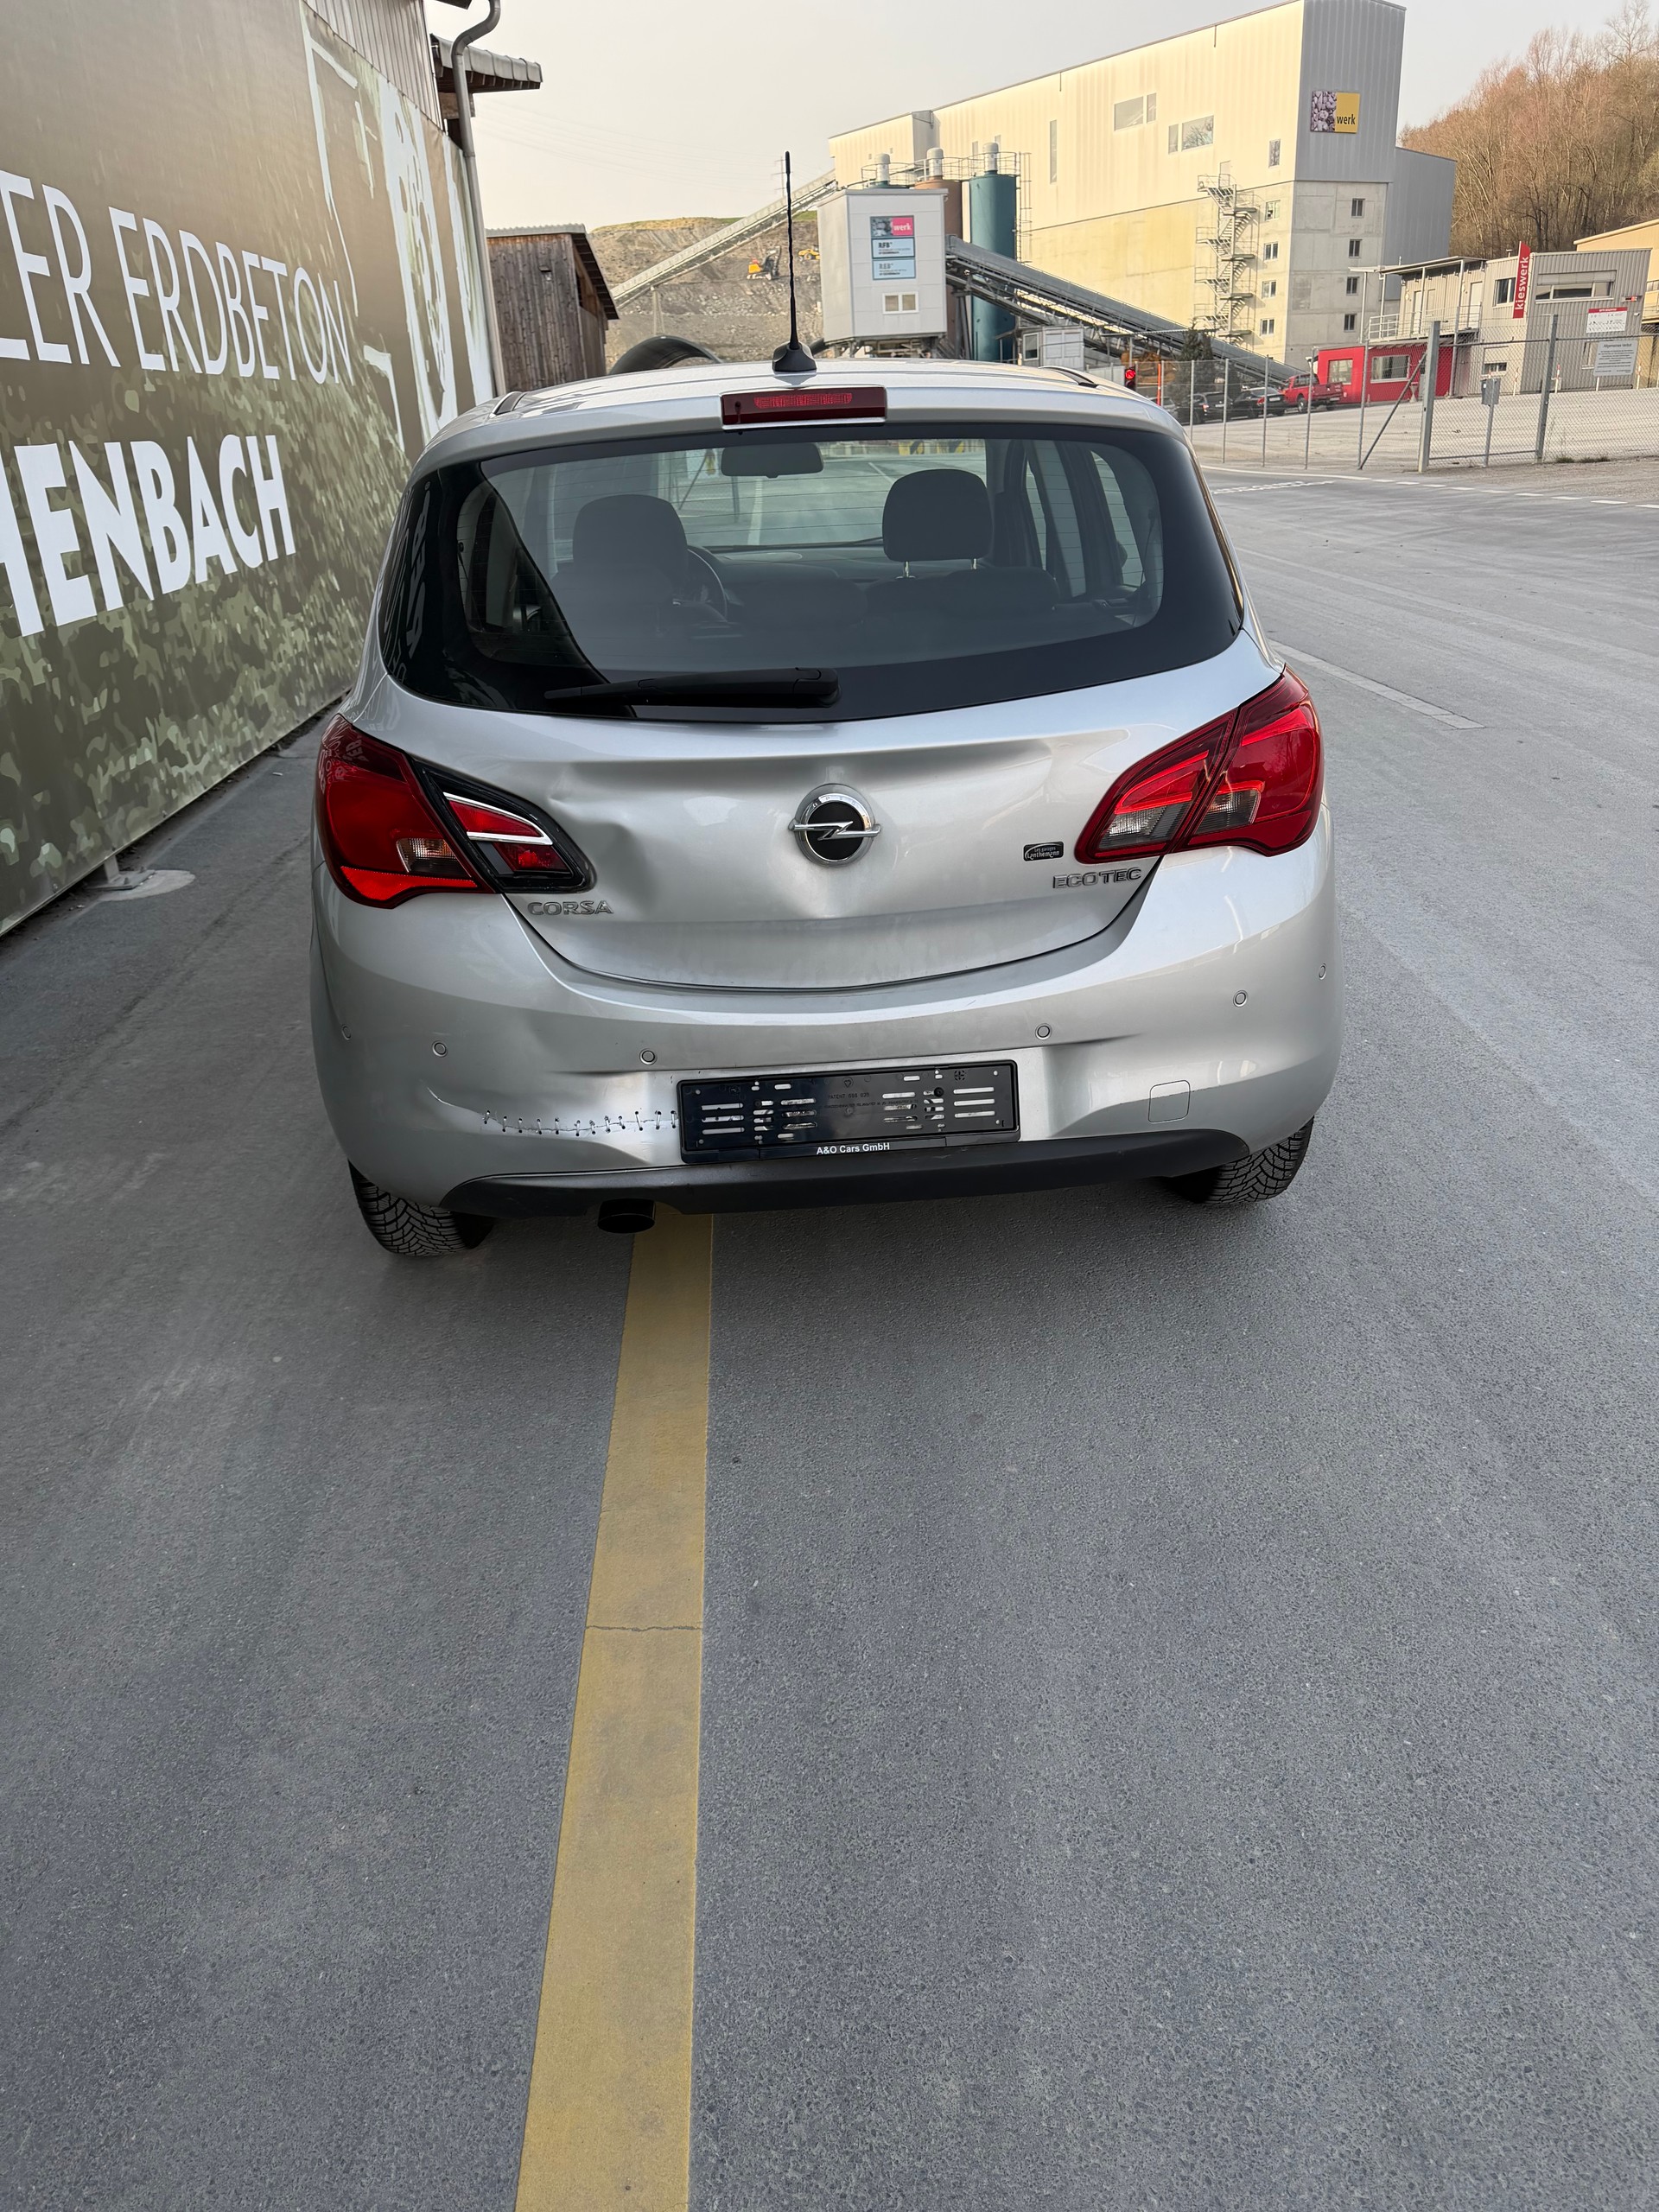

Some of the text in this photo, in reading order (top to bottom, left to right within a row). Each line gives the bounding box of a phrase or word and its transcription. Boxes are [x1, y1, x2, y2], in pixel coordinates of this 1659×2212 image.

[1337, 113, 1356, 125] werk
[893, 222, 912, 231] werk
[1514, 256, 1529, 310] kieswerk
[108, 207, 356, 386] ERDBETON
[1052, 867, 1141, 888] ECOTEC
[527, 899, 614, 916] CORSA
[817, 1142, 890, 1155] A&O Cars GmbH
